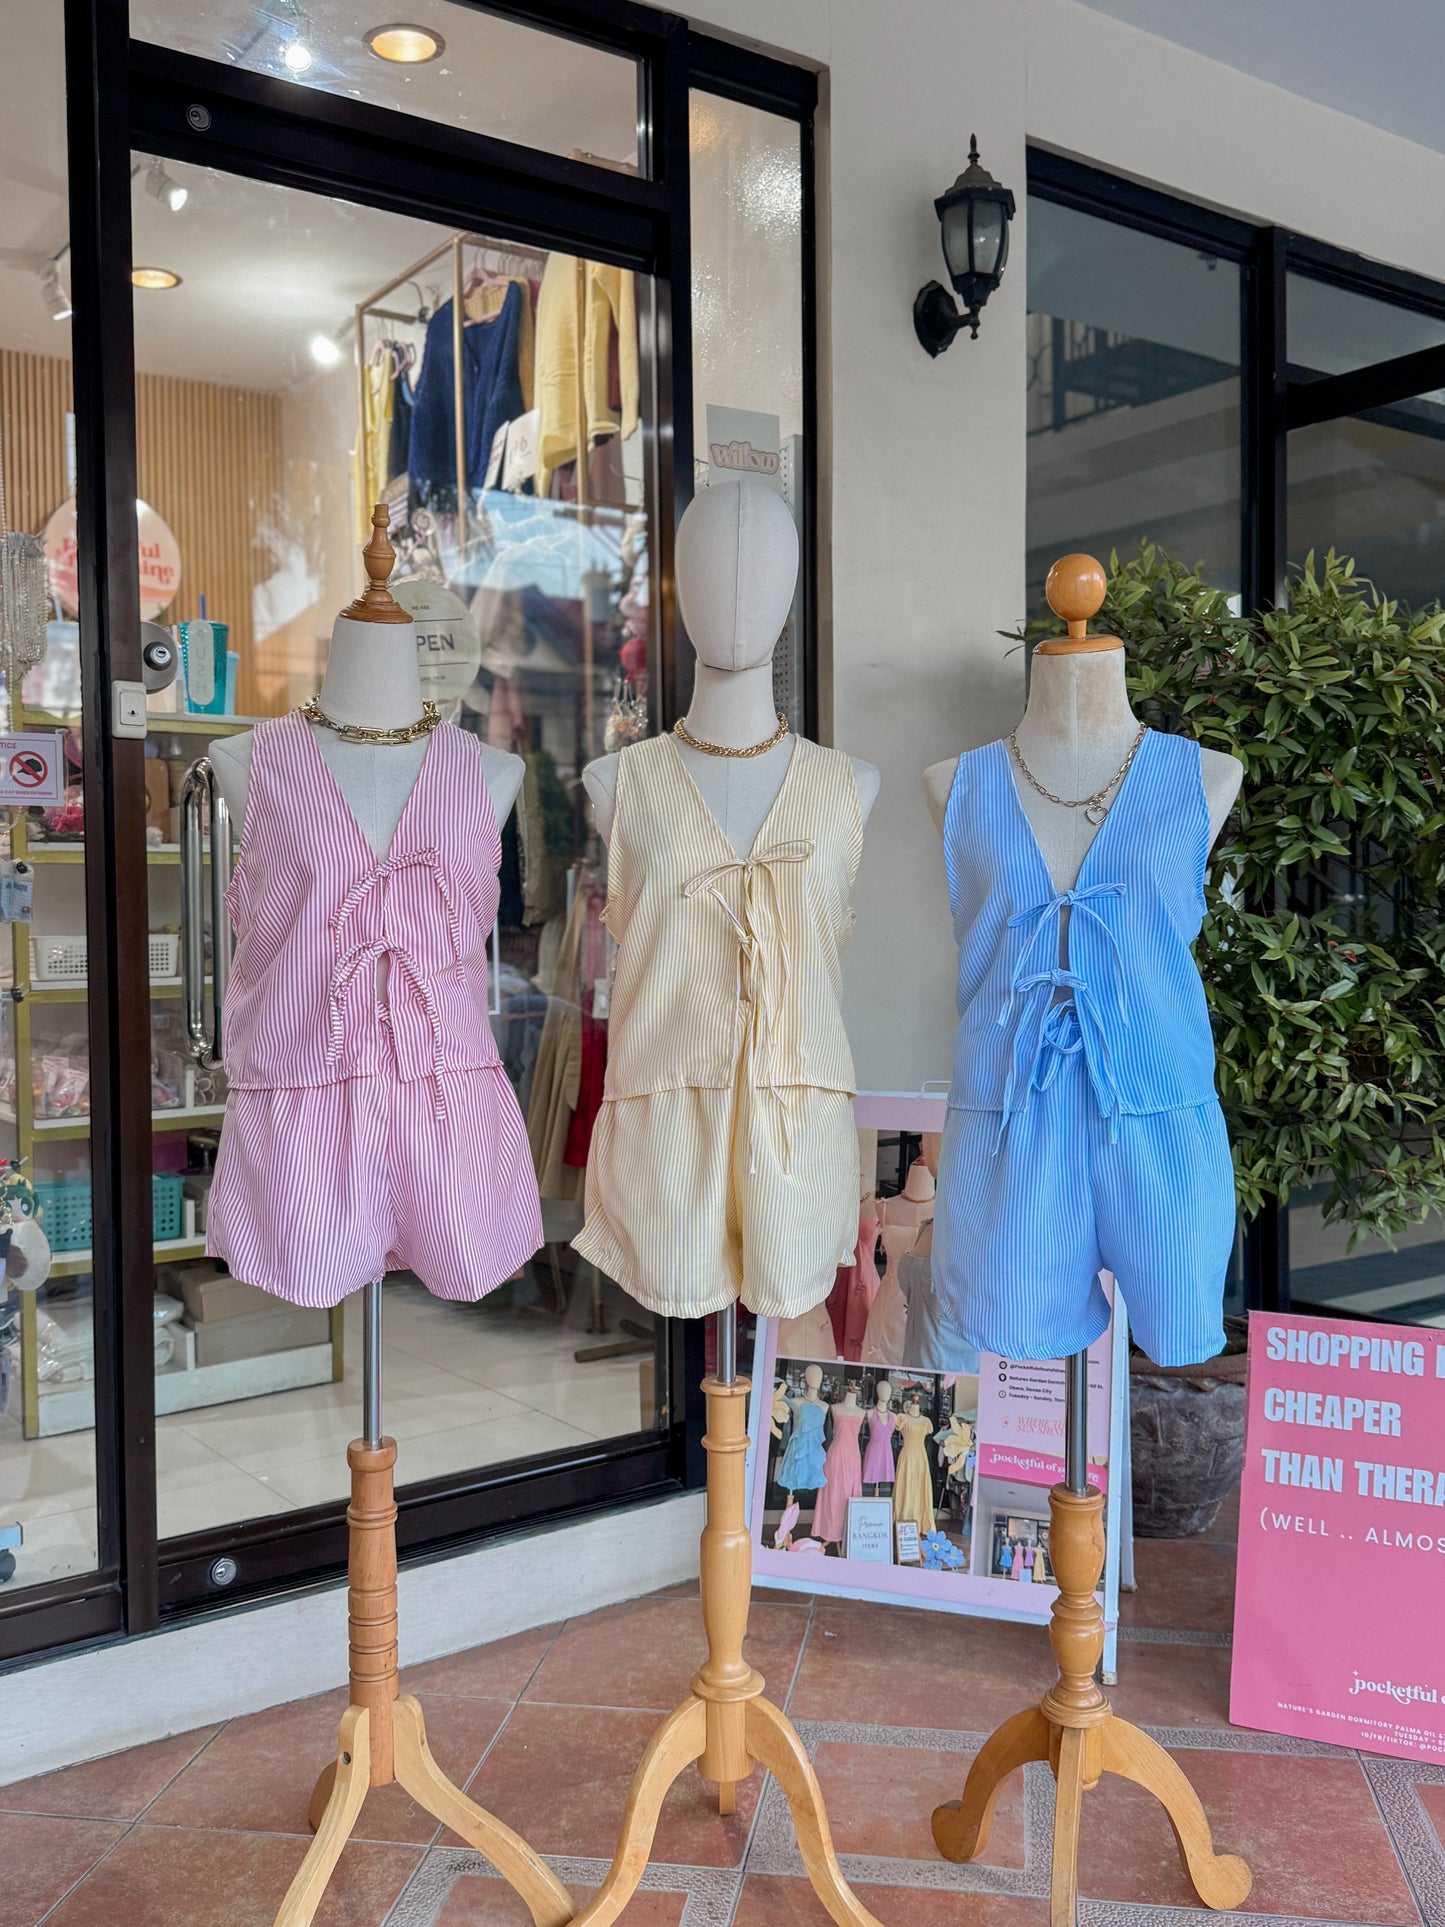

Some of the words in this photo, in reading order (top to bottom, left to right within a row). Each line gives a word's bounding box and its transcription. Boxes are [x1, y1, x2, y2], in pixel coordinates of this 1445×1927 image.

[416, 633, 455, 652] PEN
[1266, 1326, 1425, 1377] SHOPPING
[1264, 1387, 1402, 1437] CHEAPER
[989, 1452, 1045, 1470] pocketful
[1046, 1462, 1056, 1472] of
[1261, 1448, 1344, 1493] THAN
[1260, 1506, 1330, 1537] (WELL
[1348, 1677, 1438, 1705] pocketful
[1277, 1702, 1314, 1714] NATURE'S
[1315, 1709, 1346, 1720] GARDEN
[1348, 1716, 1393, 1729] DORMITORY
[1396, 1724, 1422, 1735] PALMA
[1394, 1730, 1429, 1744] TUESDAY
